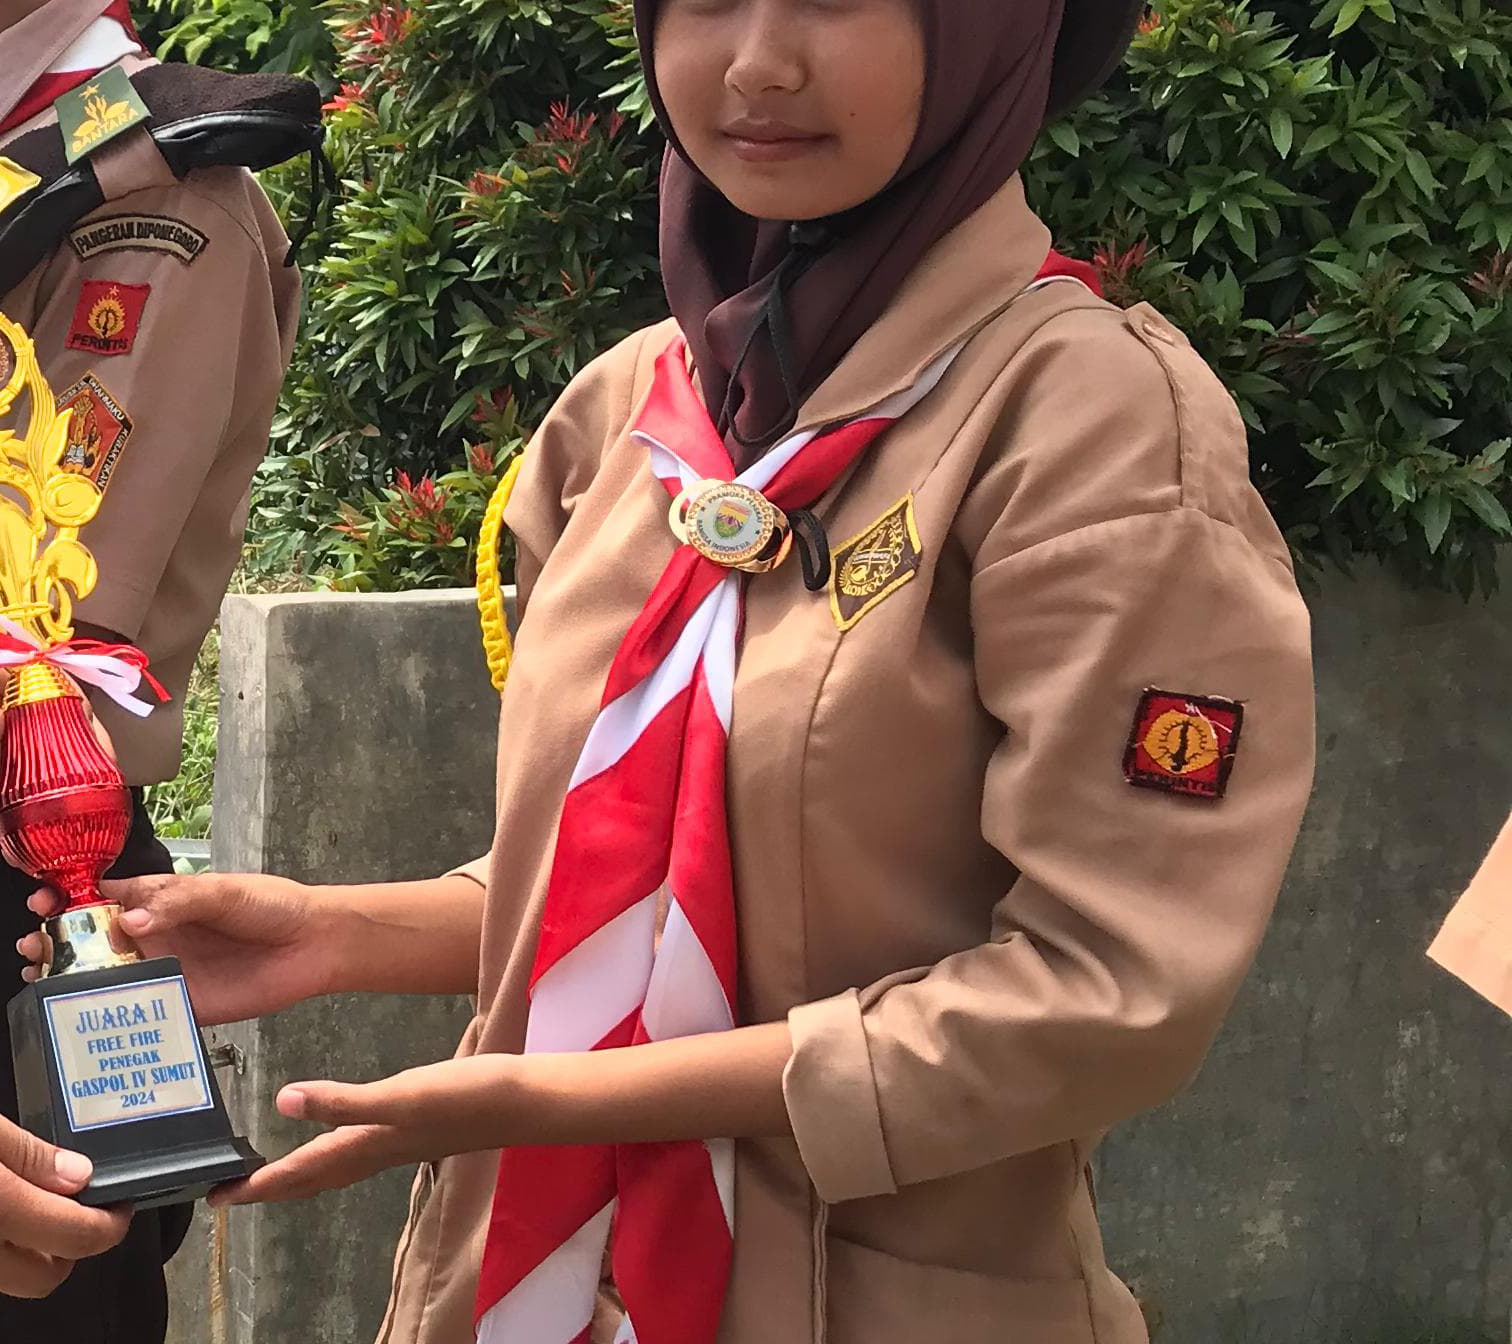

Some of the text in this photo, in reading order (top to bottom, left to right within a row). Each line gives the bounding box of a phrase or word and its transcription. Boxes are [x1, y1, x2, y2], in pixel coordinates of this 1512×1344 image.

[71, 108, 139, 153] BANTARA
[74, 221, 200, 254] PANGERAN DIPONEGORO
[711, 540, 751, 552] INDONESIA
[75, 999, 169, 1035] JUARA II
[87, 1028, 165, 1055] FREE FIRE
[98, 1049, 162, 1072] PENEGAK
[71, 1061, 196, 1098] GASPOL IV SUMUT
[120, 1089, 157, 1108] 2024
